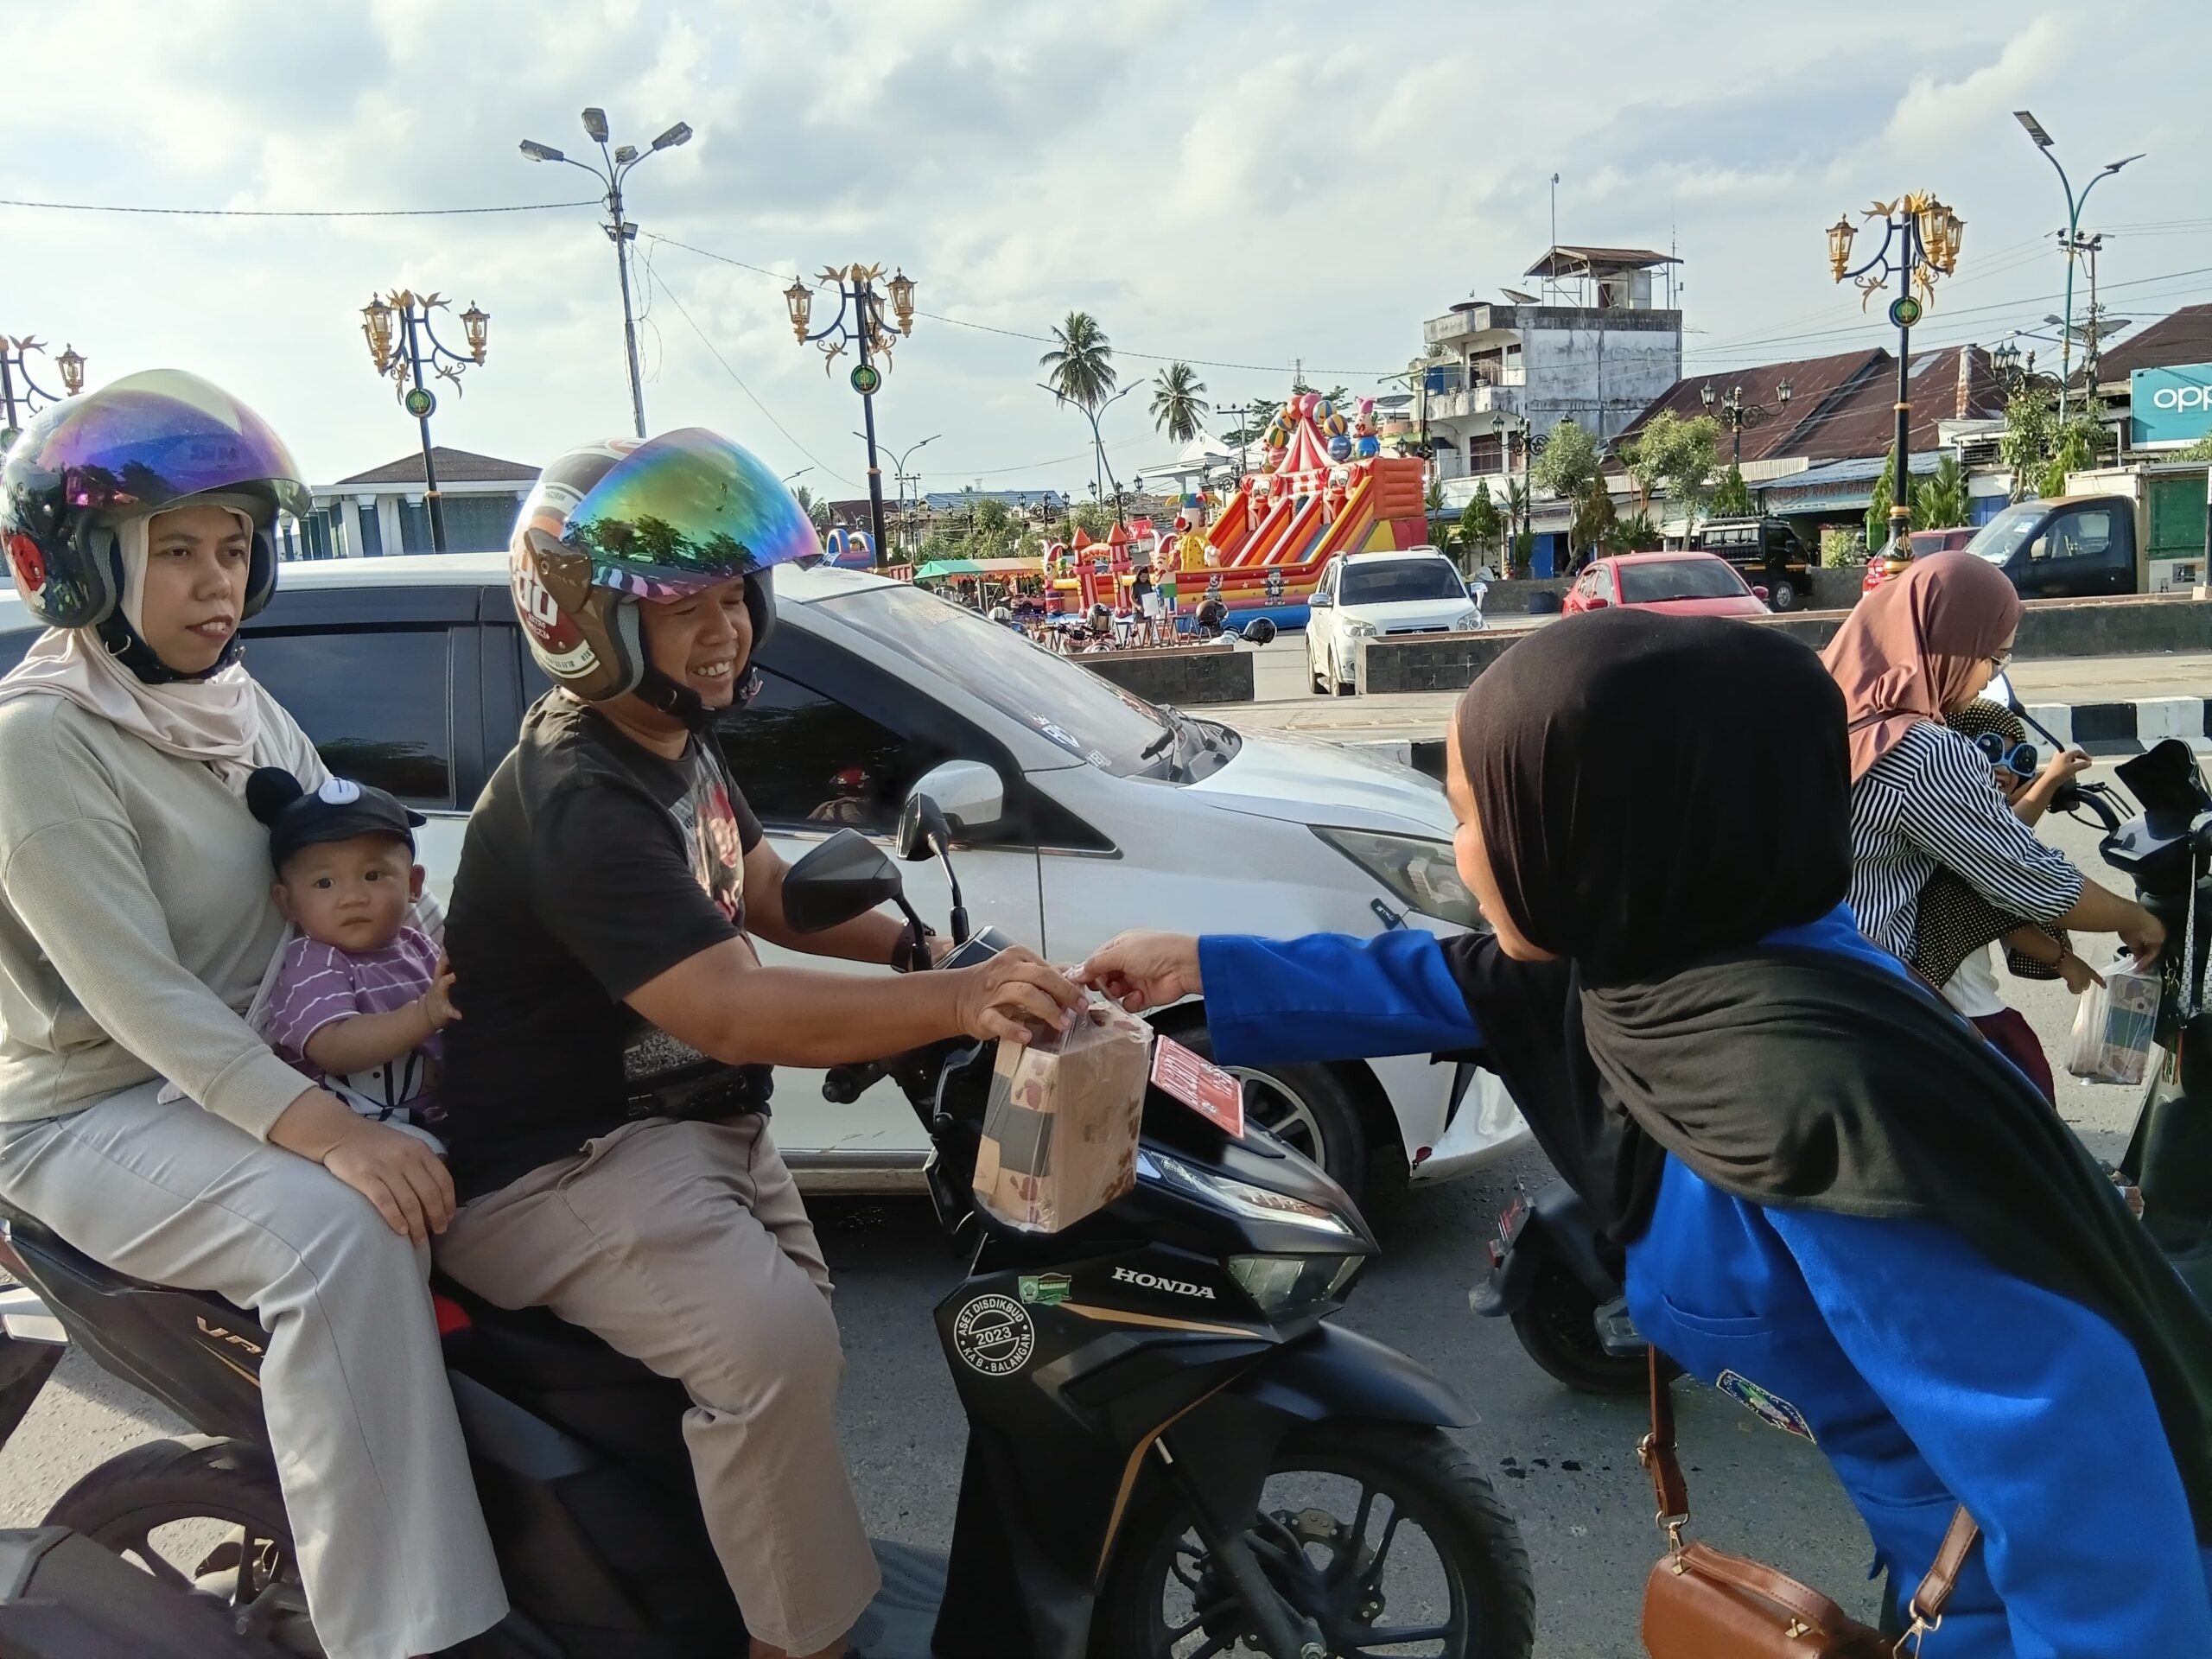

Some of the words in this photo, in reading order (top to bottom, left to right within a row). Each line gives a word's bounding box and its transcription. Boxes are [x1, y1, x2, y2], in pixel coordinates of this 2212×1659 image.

[1813, 484, 1842, 498] RISKY
[1162, 1074, 1198, 1107] DA
[1111, 1267, 1217, 1299] HONDA
[958, 1308, 974, 1336] ASET
[972, 1298, 1025, 1322] DISDIKBUD
[196, 1316, 264, 1357] VA
[976, 1326, 1012, 1345] 2023
[990, 1333, 1031, 1372] BALANGAN
